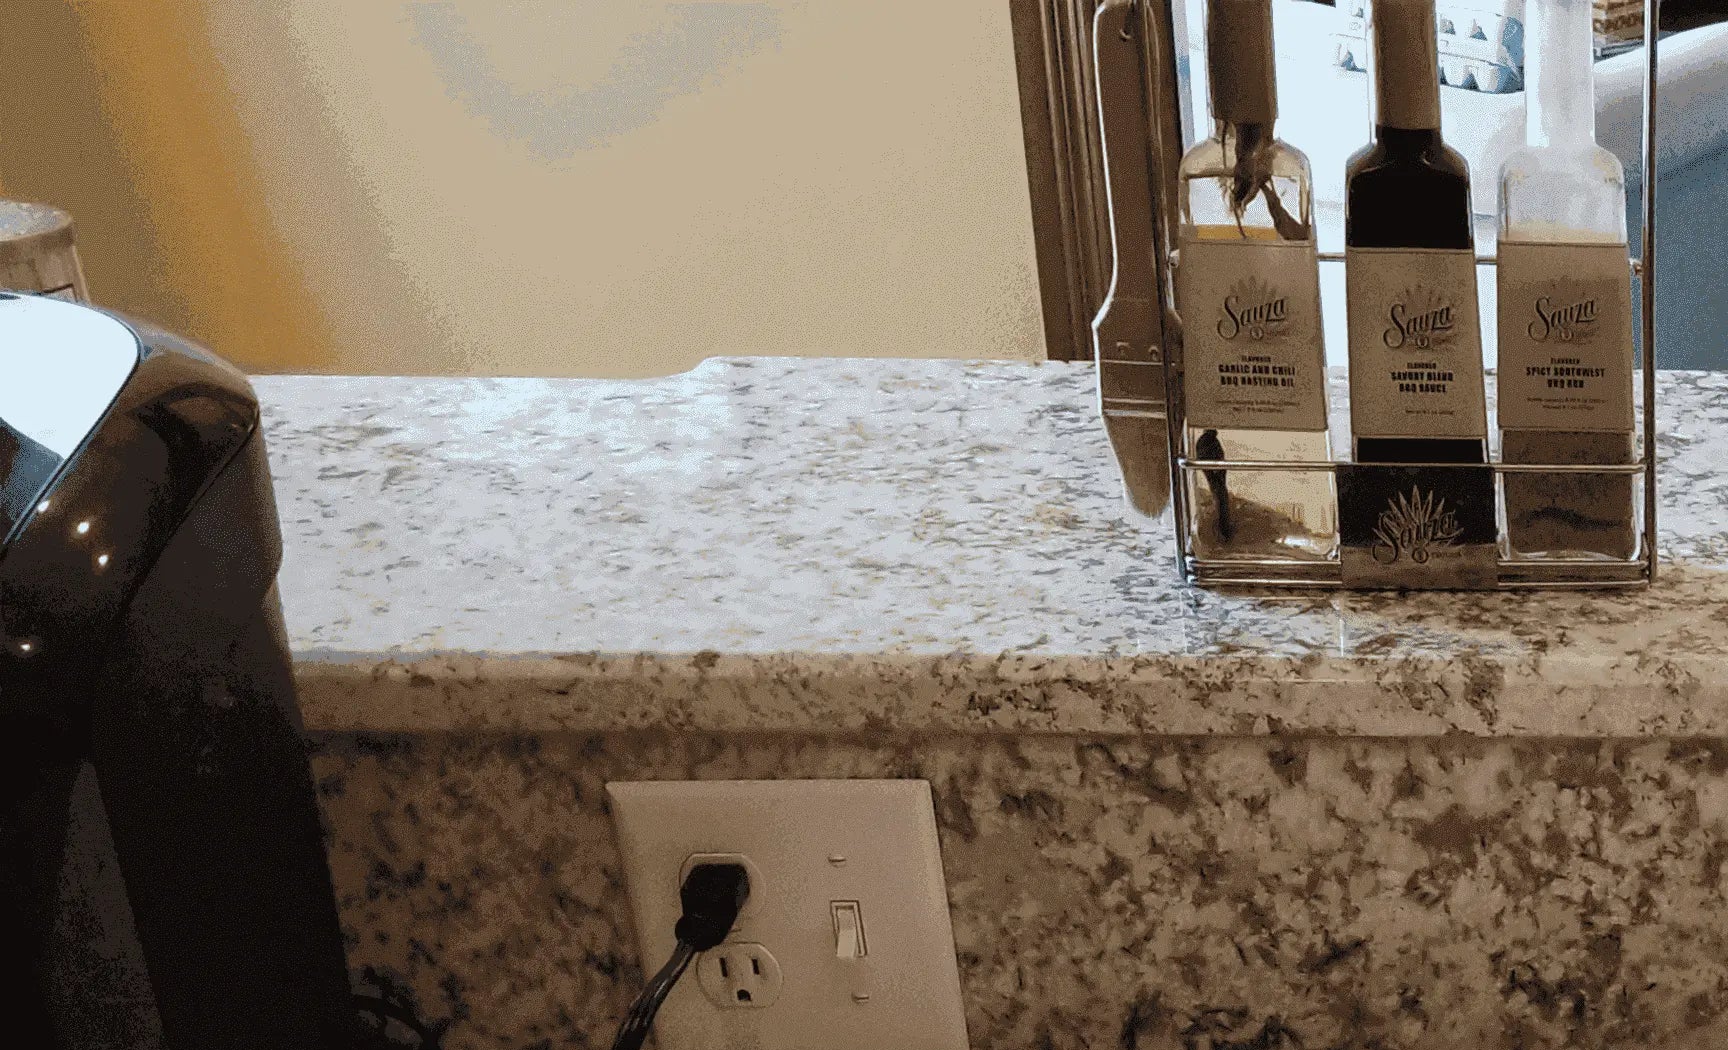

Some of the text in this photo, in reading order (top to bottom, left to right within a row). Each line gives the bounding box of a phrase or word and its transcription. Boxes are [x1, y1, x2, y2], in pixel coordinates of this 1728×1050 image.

[1217, 295, 1288, 340] Sauza
[1383, 303, 1454, 348] Sauza
[1528, 296, 1598, 341] Sauza
[1218, 364, 1250, 374] GARLIC
[1252, 365, 1270, 375] AND
[1281, 377, 1294, 388] OIL
[1526, 366, 1605, 377] SPICY SOUTHWEST
